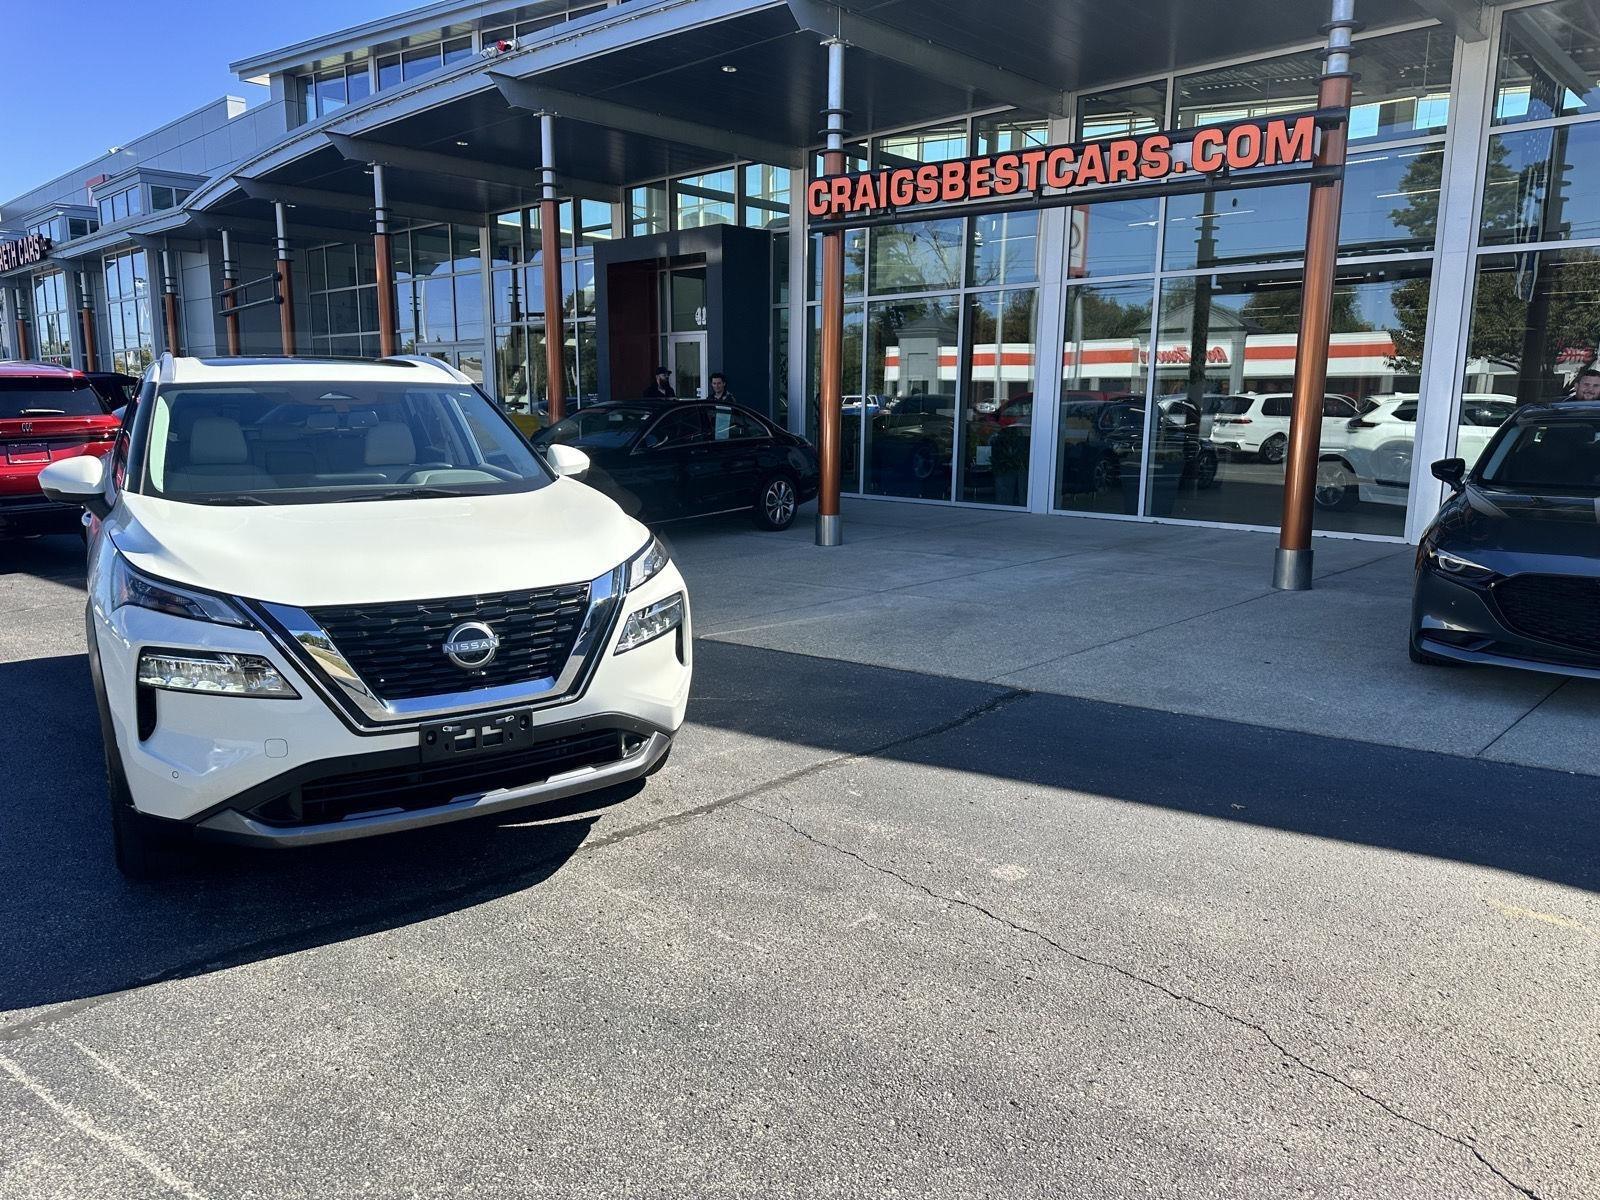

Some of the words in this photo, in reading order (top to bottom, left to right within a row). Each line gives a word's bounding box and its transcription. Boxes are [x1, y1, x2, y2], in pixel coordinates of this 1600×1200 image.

[808, 115, 1316, 217] CRAIGSBESTCARS.COM
[18, 233, 41, 265] CARS
[444, 638, 499, 652] NISSAN
